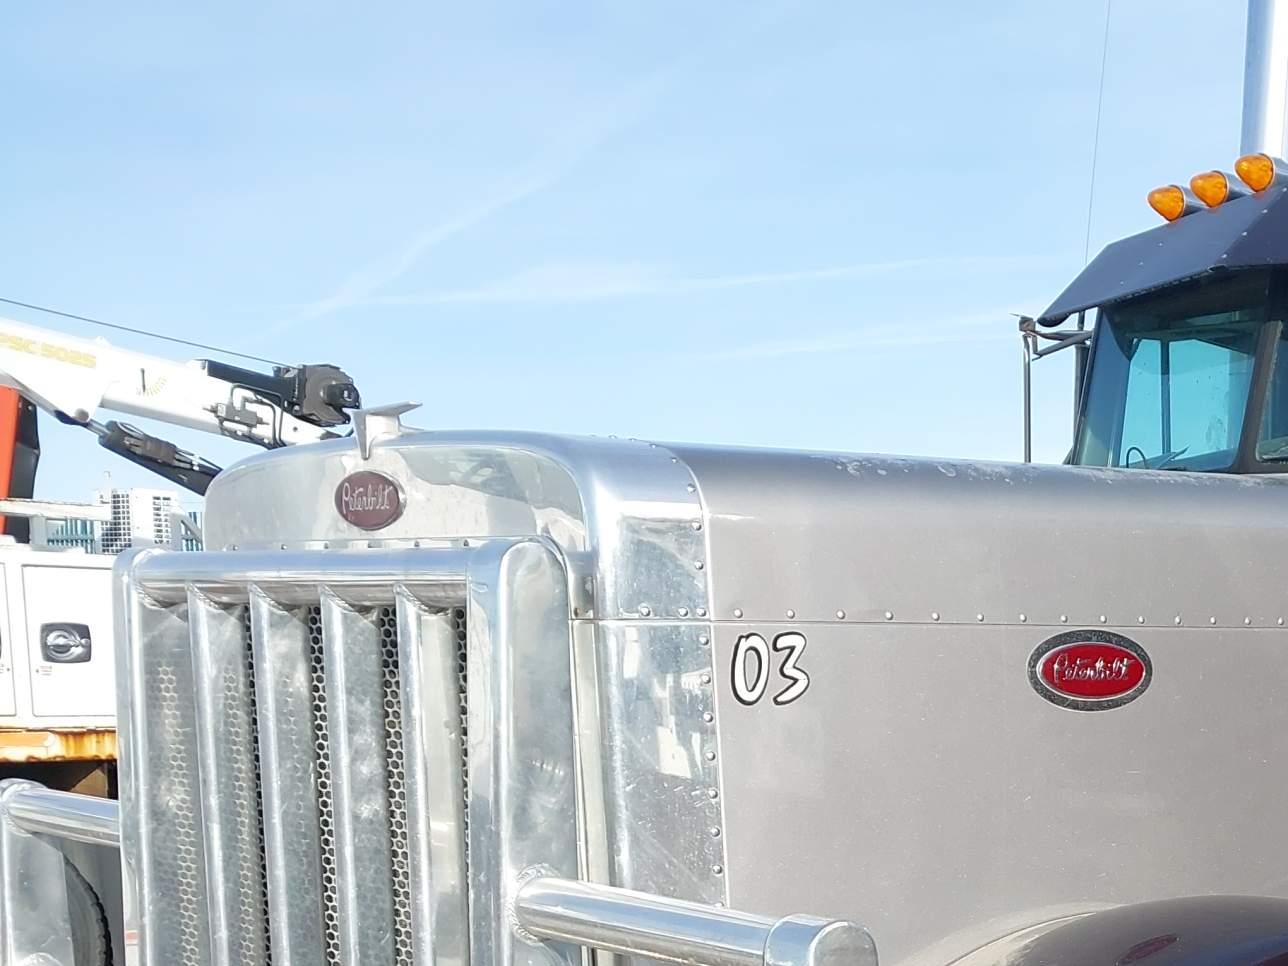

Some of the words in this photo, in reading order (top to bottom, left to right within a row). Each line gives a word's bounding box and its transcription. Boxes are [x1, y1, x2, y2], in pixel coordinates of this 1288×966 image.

[341, 482, 393, 514] Peterbilt
[730, 631, 810, 706] 03
[1052, 653, 1136, 683] Peterbilt
